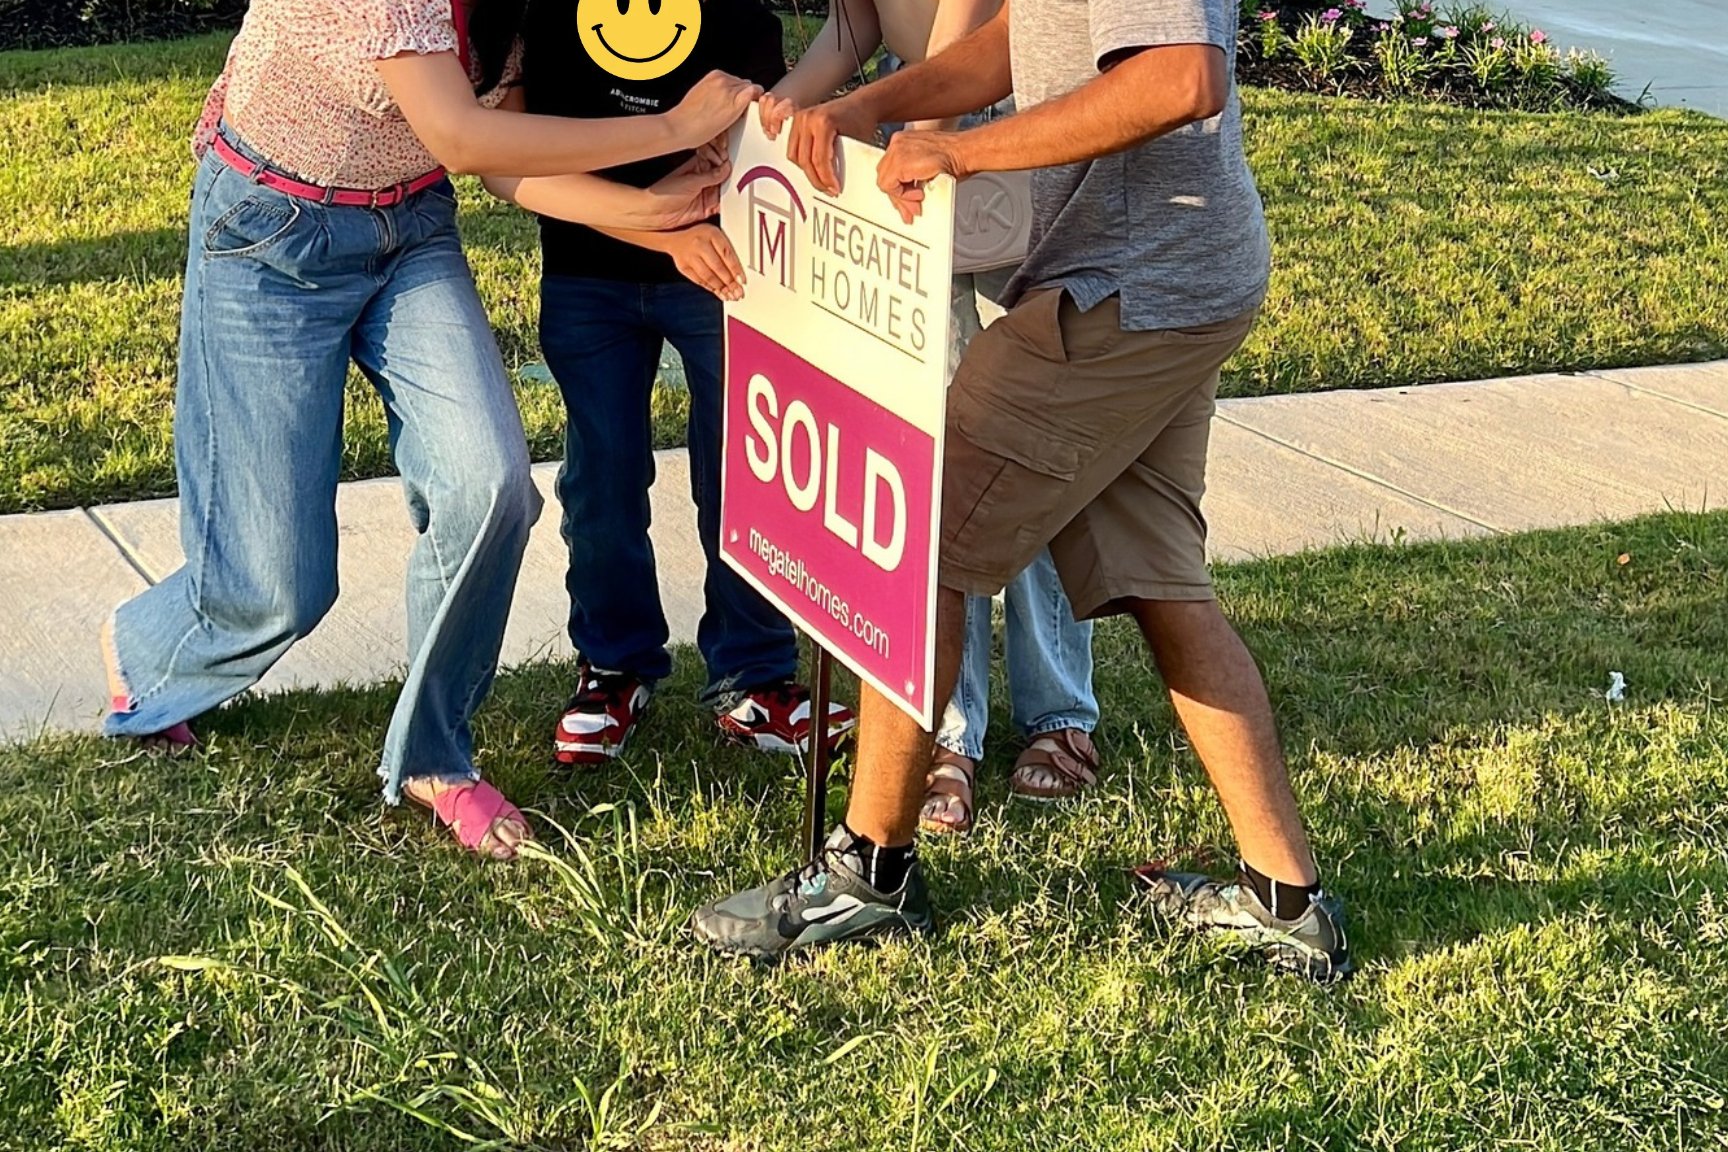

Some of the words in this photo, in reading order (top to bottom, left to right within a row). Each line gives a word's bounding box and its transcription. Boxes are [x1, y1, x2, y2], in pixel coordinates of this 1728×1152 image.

[812, 206, 928, 298] MEGATEL
[812, 256, 926, 352] HOMES
[745, 373, 907, 572] SOLD
[749, 527, 890, 659] megatelhomes.com
